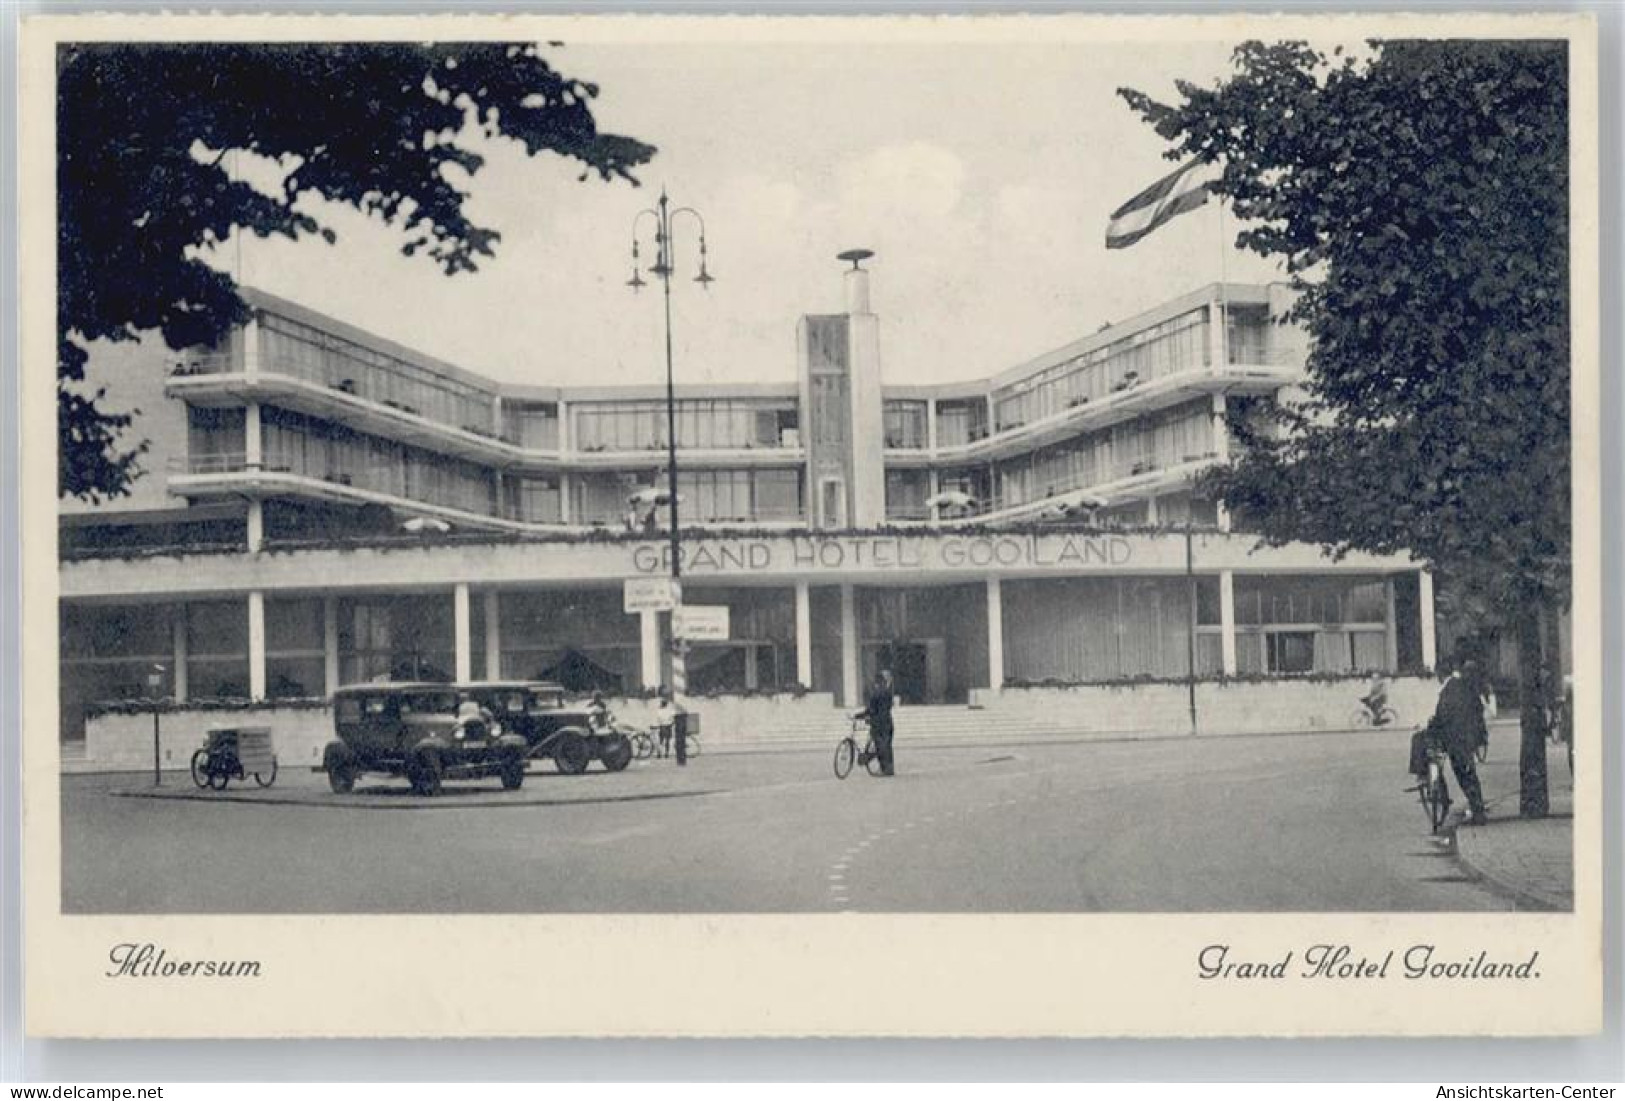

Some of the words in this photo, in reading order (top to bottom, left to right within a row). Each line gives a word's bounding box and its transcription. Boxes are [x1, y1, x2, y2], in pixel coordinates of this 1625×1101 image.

[633, 543, 771, 573] GRAND
[794, 538, 921, 567] HOTEL
[941, 536, 1132, 567] GOOILAND
[105, 943, 262, 977] Hilversum
[1198, 945, 1293, 979] Grand
[1301, 945, 1394, 979] Hotel
[1403, 945, 1541, 979] Gooiland.
